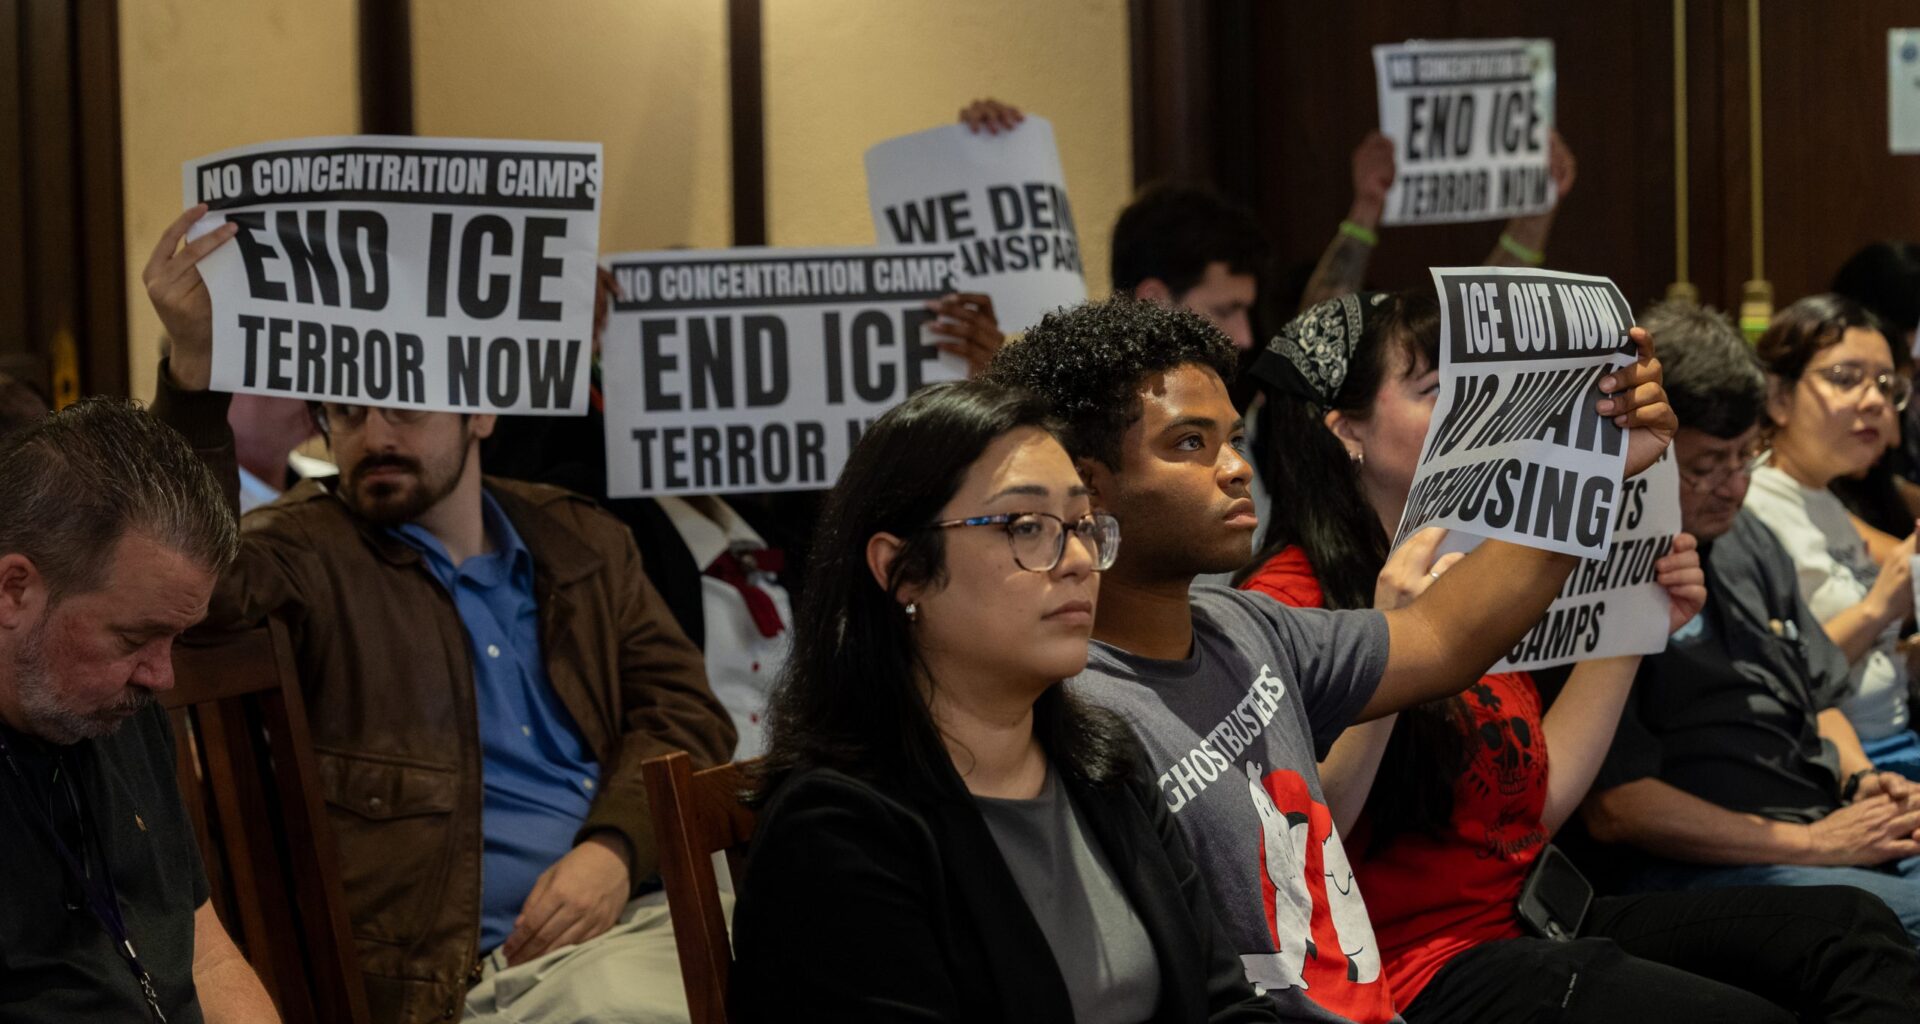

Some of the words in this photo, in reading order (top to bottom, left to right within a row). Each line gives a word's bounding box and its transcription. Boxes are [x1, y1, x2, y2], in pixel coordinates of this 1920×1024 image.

[1406, 94, 1475, 161] END
[1489, 90, 1541, 155] ICE
[203, 163, 242, 199] NO
[252, 153, 488, 196] CONCENTRATION
[499, 159, 599, 199] CAMPS
[1401, 169, 1490, 217] TERROR
[1499, 166, 1549, 208] NOW
[884, 190, 976, 245] WE
[226, 209, 389, 312] END
[426, 212, 568, 322] ICE
[615, 266, 653, 303] NO
[659, 260, 867, 300] CONCENTRATION
[872, 256, 961, 294] CAMPS
[1459, 281, 1506, 354] ICE
[1507, 281, 1559, 352] OUT
[1555, 284, 1630, 351] NOW!
[238, 313, 425, 404] TERROR
[447, 334, 581, 410] NOW
[640, 312, 791, 413] END
[822, 306, 940, 406] ICE
[1422, 373, 1500, 465] NO
[1464, 362, 1624, 457] HUMAN
[632, 421, 826, 491] TERROR
[1157, 664, 1286, 813] GHOSTBUSTERS
